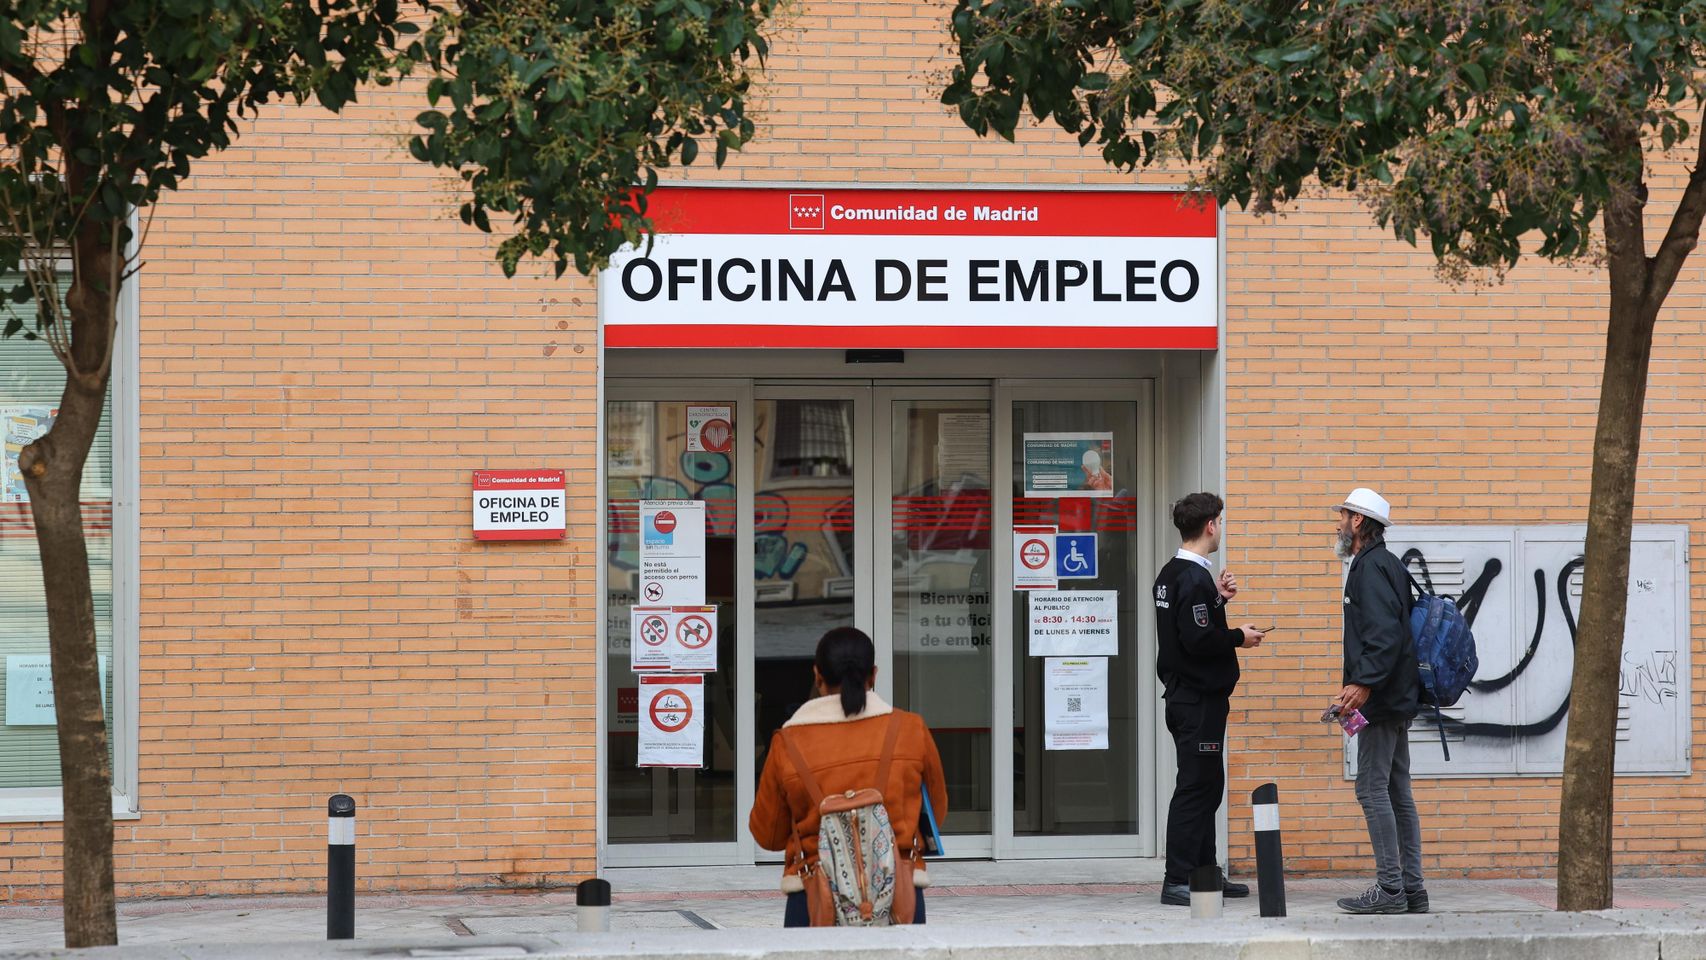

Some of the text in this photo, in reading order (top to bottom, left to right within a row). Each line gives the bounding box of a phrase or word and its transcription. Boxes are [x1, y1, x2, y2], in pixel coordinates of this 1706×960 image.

[830, 205, 1038, 221] Comunidad de Madrid
[621, 257, 1200, 303] OFICINA DE EMPLEO
[479, 496, 560, 509] OFICINA DE
[490, 511, 549, 523] EMPLEO
[920, 616, 929, 627] a
[935, 614, 951, 627] tu
[1042, 615, 1063, 623] 8:30
[1071, 615, 1096, 623] 14:30
[920, 633, 940, 646] de
